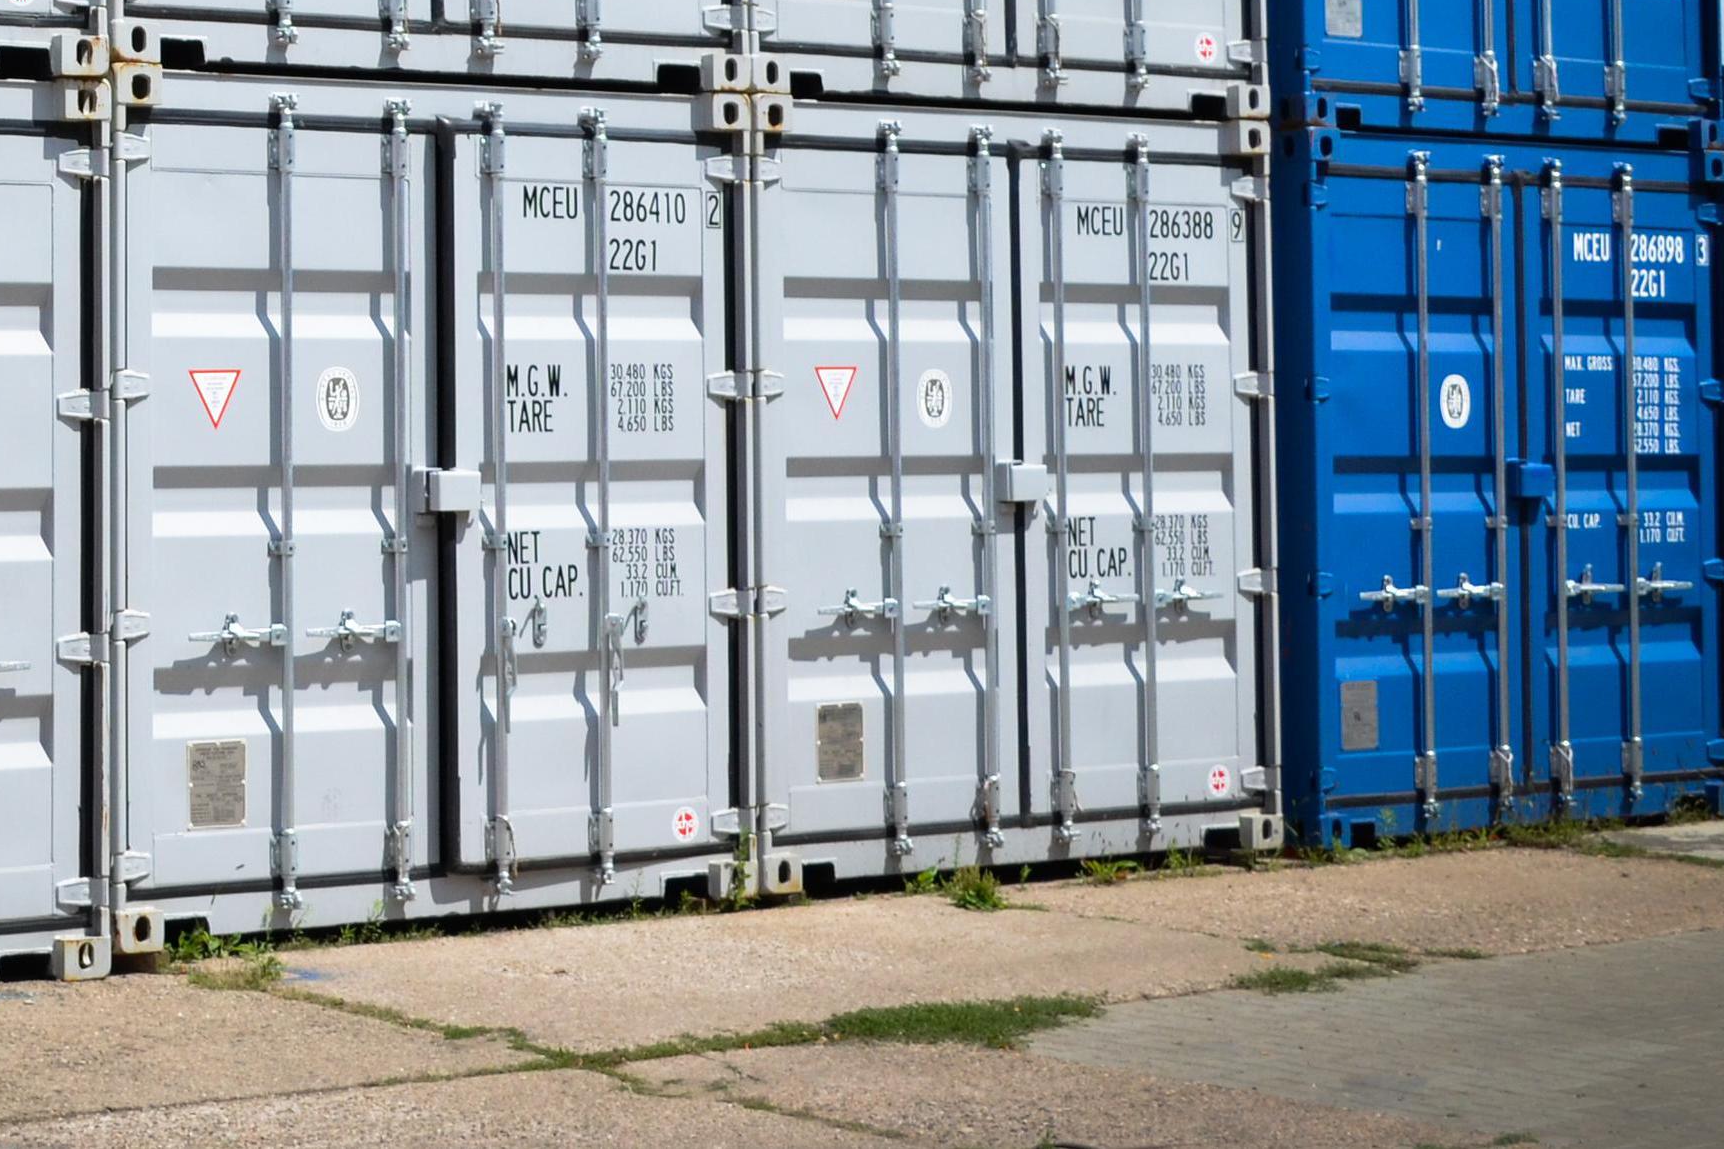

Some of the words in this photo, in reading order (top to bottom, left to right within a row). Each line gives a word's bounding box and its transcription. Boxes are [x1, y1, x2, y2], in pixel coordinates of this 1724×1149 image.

[523, 186, 577, 219] MCEU
[610, 190, 685, 223] 286410
[709, 195, 719, 226] 2
[1077, 206, 1123, 235] MCEU
[1150, 210, 1213, 239] 286388
[1232, 212, 1241, 238] 9
[609, 238, 657, 271] 22G1
[1573, 233, 1610, 262] MCEU
[1630, 234, 1684, 263] 286898
[1698, 237, 1704, 263] 3
[1149, 252, 1188, 281] 22G1
[1631, 269, 1665, 298] 22G1
[508, 400, 554, 432] TARE
[1066, 397, 1105, 426] TARE
[1068, 517, 1095, 547] NET
[508, 531, 540, 565] NET
